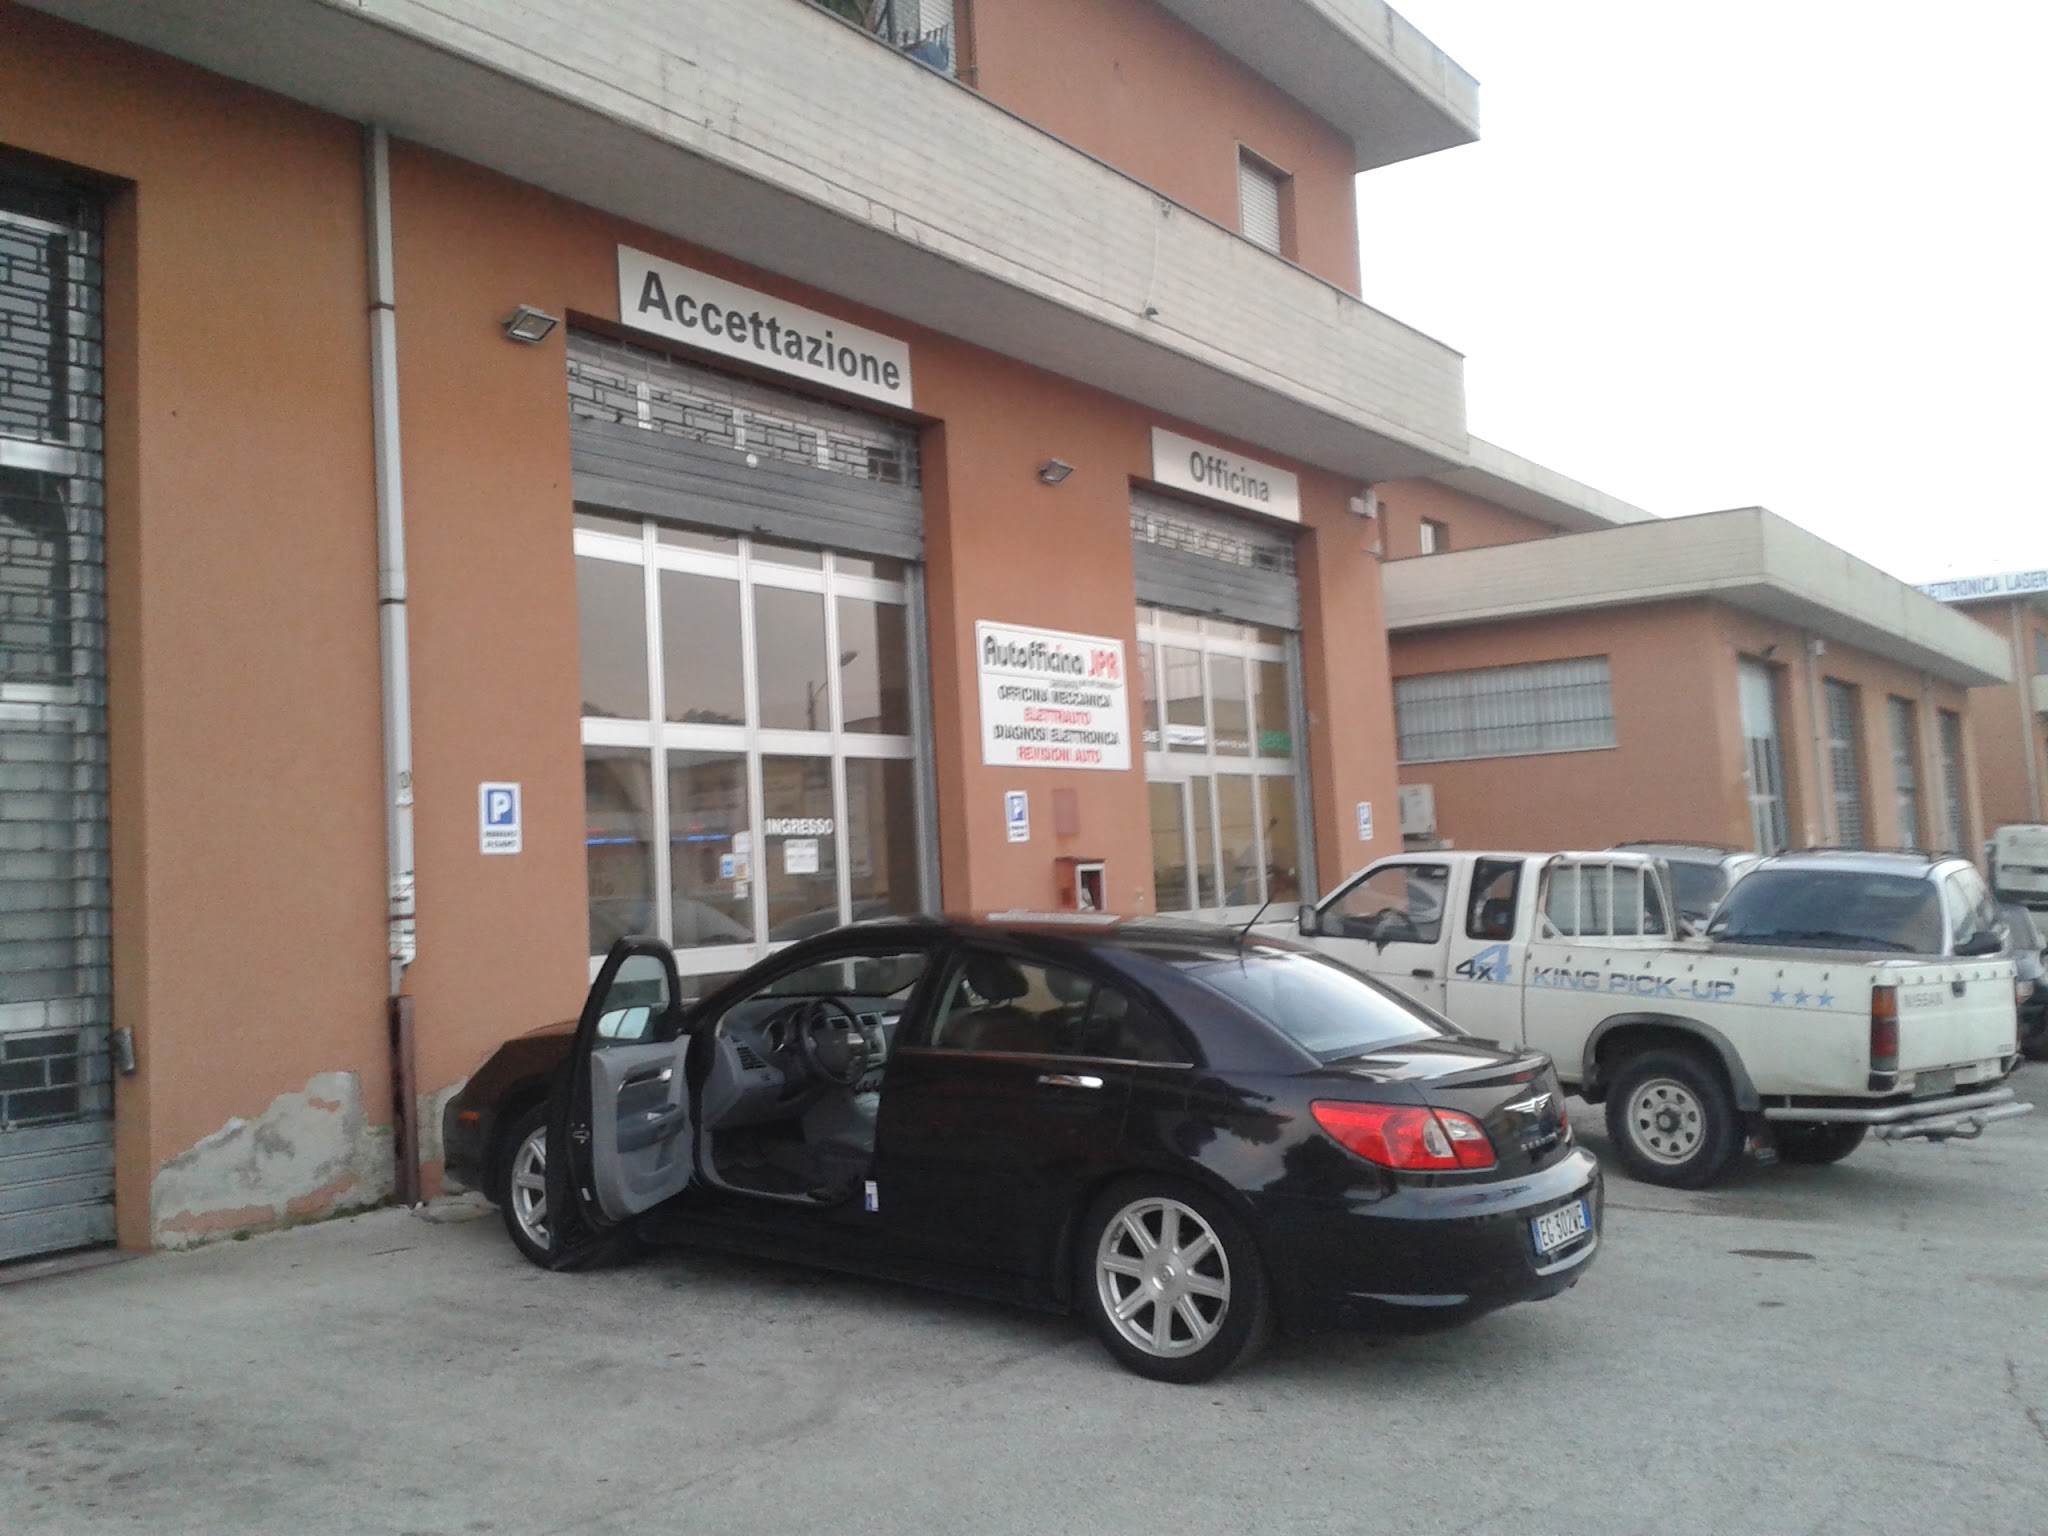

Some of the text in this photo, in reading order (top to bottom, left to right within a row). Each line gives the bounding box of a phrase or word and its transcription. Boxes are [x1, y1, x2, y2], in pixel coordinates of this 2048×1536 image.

[638, 270, 900, 391] Accettazione
[1189, 451, 1270, 503] Officina
[1914, 576, 1999, 599] ETTRONICA
[983, 635, 1085, 675] Autofficina
[998, 685, 1112, 708] OFFICINA MECCANICA
[1024, 707, 1092, 726] ELETTRAUTO
[994, 725, 1120, 745] DIAGNOSI ELETTRONICA
[1075, 749, 1102, 763] AUTO
[489, 791, 512, 823] P
[767, 817, 834, 836] INGRESSO
[1534, 966, 1736, 999] KING PICK-UP
